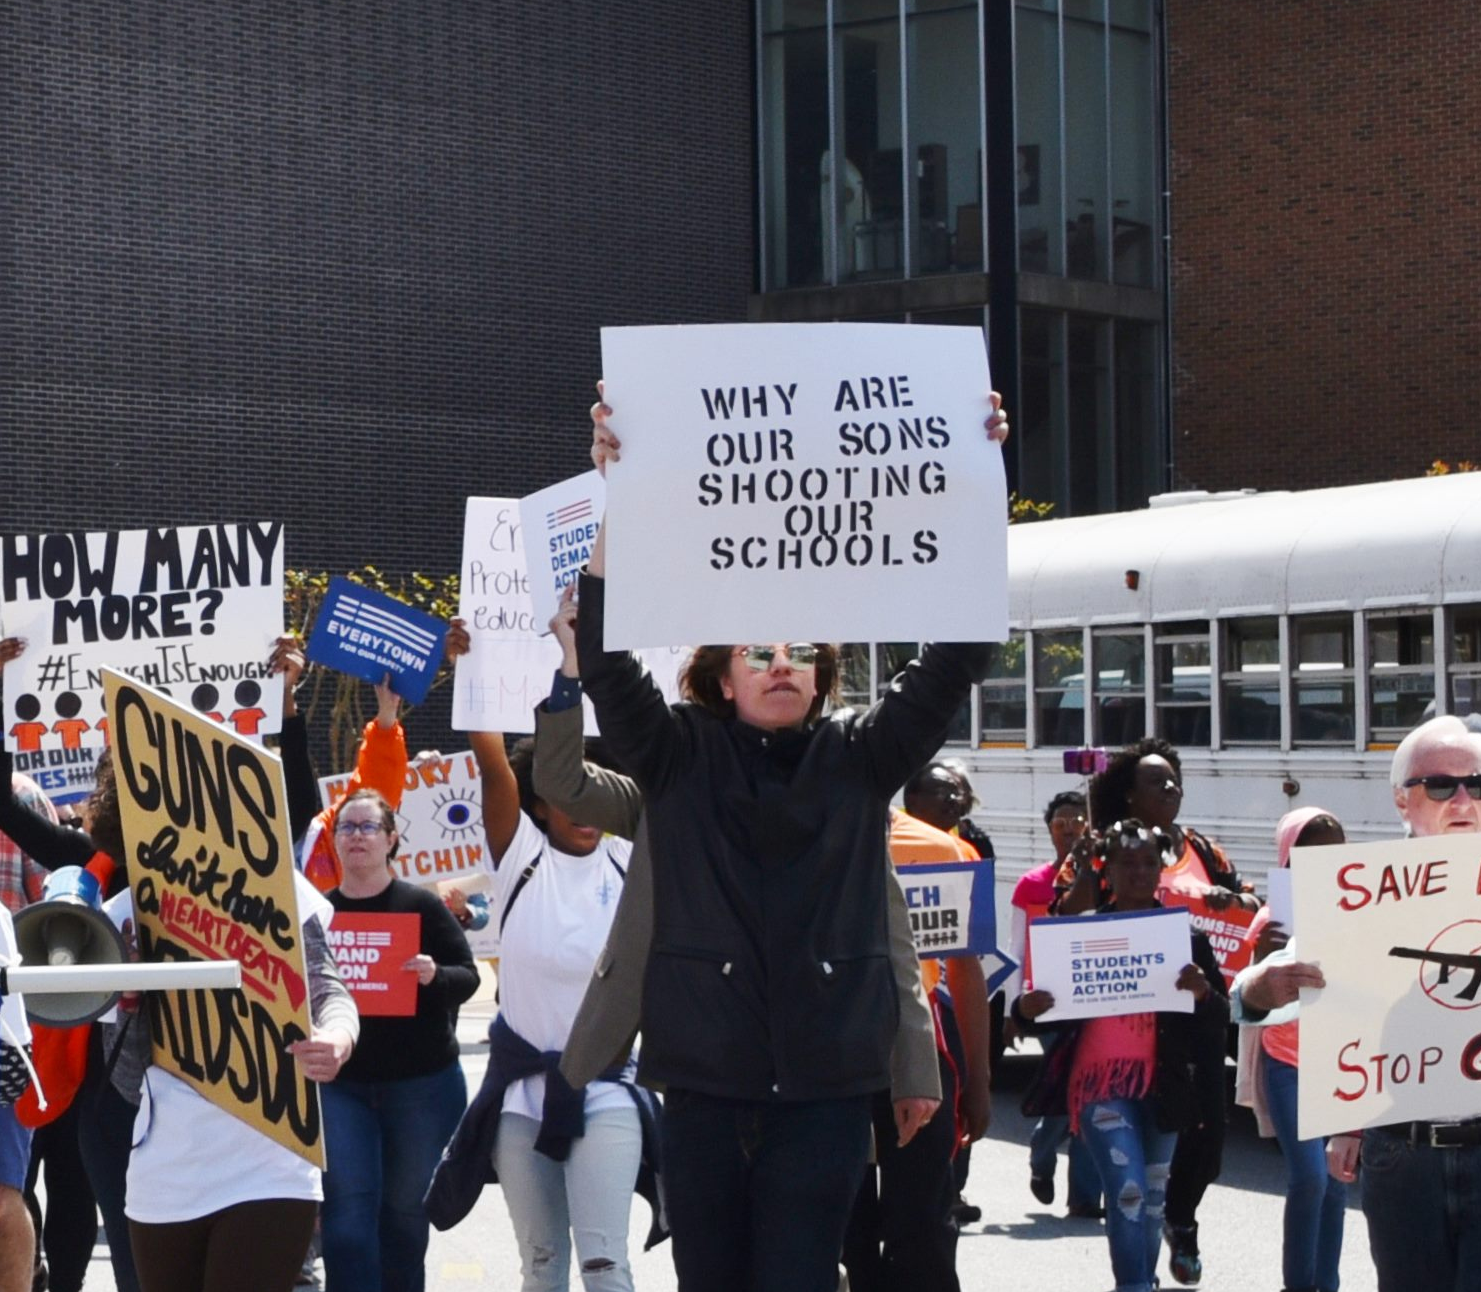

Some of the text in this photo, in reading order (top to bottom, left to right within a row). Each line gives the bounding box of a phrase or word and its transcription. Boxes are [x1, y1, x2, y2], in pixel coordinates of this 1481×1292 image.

[701, 375, 913, 420] WHY ARE
[706, 416, 950, 467] OUR SONS
[698, 460, 946, 507] SHOOTING
[549, 522, 600, 553] STUDE
[784, 500, 874, 538] OUR
[2, 521, 284, 602] HOW MANY
[551, 543, 595, 571] DEMA
[710, 530, 939, 570] SCHOOLS
[554, 568, 579, 592] ACT
[53, 589, 224, 645] MORE?
[326, 619, 426, 672] EVERYTOWN
[339, 641, 357, 653] FOR
[377, 656, 405, 673] SAFETY
[50, 748, 93, 768] OUR
[114, 685, 279, 879] GUNS
[136, 825, 295, 951] don't have
[1336, 860, 1448, 911] SAVE
[326, 930, 355, 946] MS
[1071, 952, 1165, 970] STUDENTS
[1072, 968, 1148, 983] DEMAND
[1072, 981, 1138, 996] ACTION
[1333, 1038, 1443, 1101] STOP
